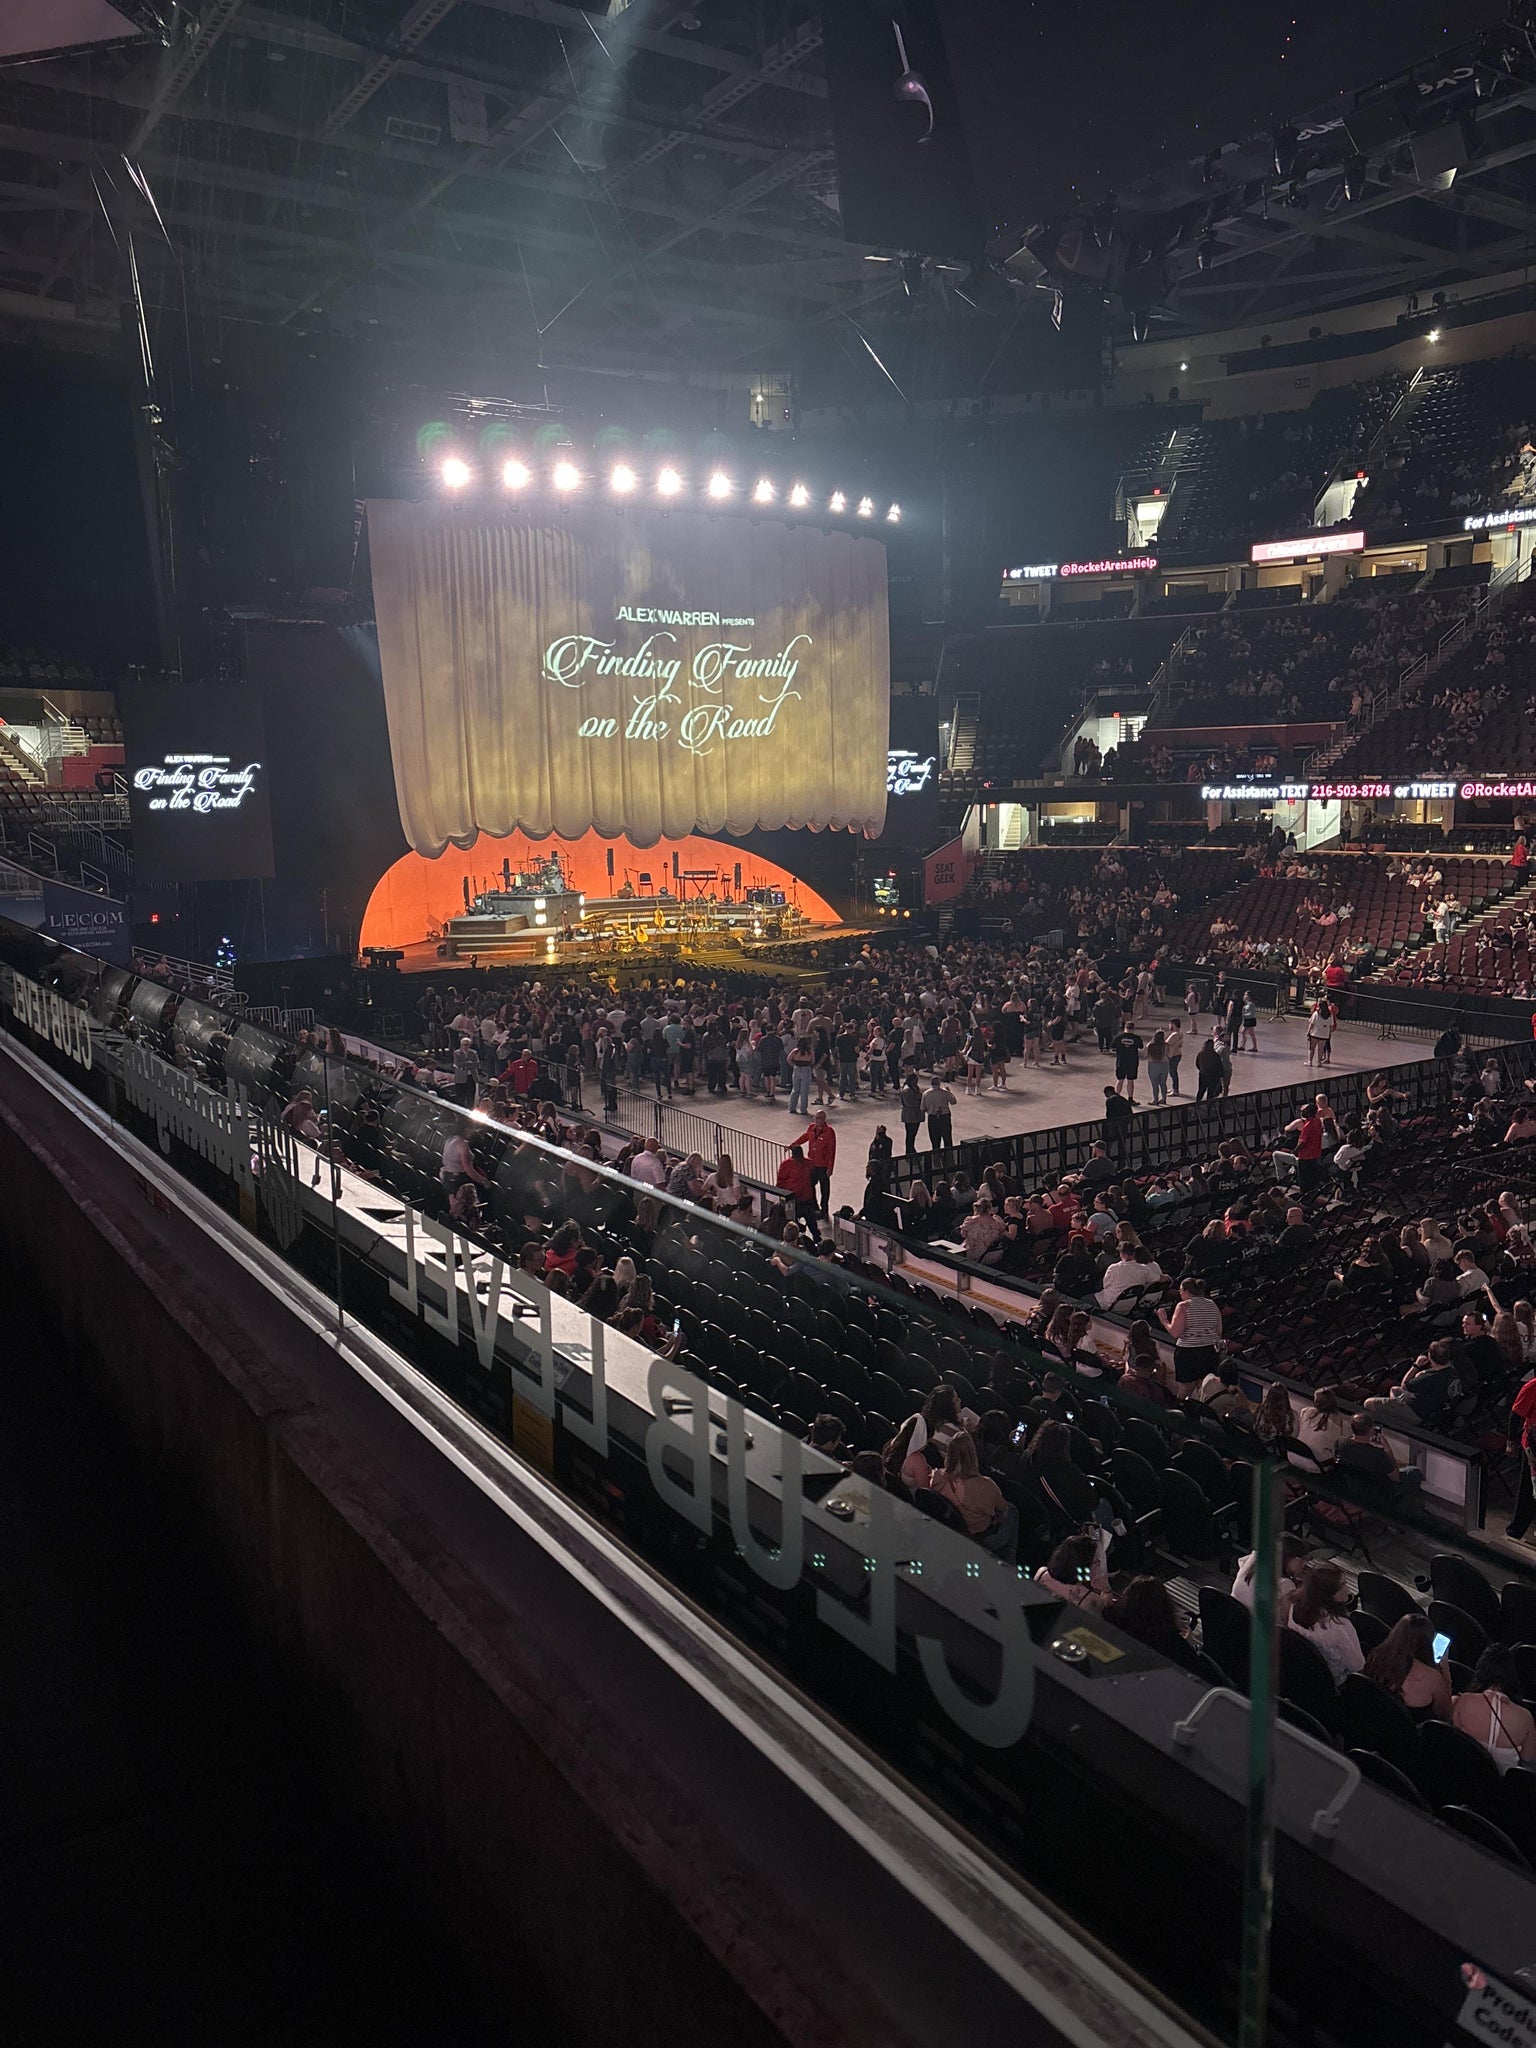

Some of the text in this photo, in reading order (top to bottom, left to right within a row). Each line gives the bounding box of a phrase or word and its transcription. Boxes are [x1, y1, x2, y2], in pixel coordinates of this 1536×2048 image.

[1464, 517, 1485, 530] For
[1010, 569, 1023, 578] or
[1023, 565, 1058, 578] TWEET
[1060, 557, 1158, 577] @RocketArenaHelp
[617, 606, 657, 623] ALEX
[657, 608, 720, 626] WARREN
[542, 631, 813, 702] Finding Family
[578, 691, 801, 756] on the Road
[133, 763, 261, 793] Finding Family
[149, 787, 255, 813] on the Road
[1201, 786, 1223, 799] For
[1223, 784, 1280, 798] Assistance
[1280, 784, 1309, 798] TEXT
[1311, 784, 1391, 798] 216-503-8784
[1394, 785, 1411, 798] or
[1410, 783, 1457, 798] TWEET
[935, 862, 955, 873] SEAT
[934, 874, 955, 884] GEEK
